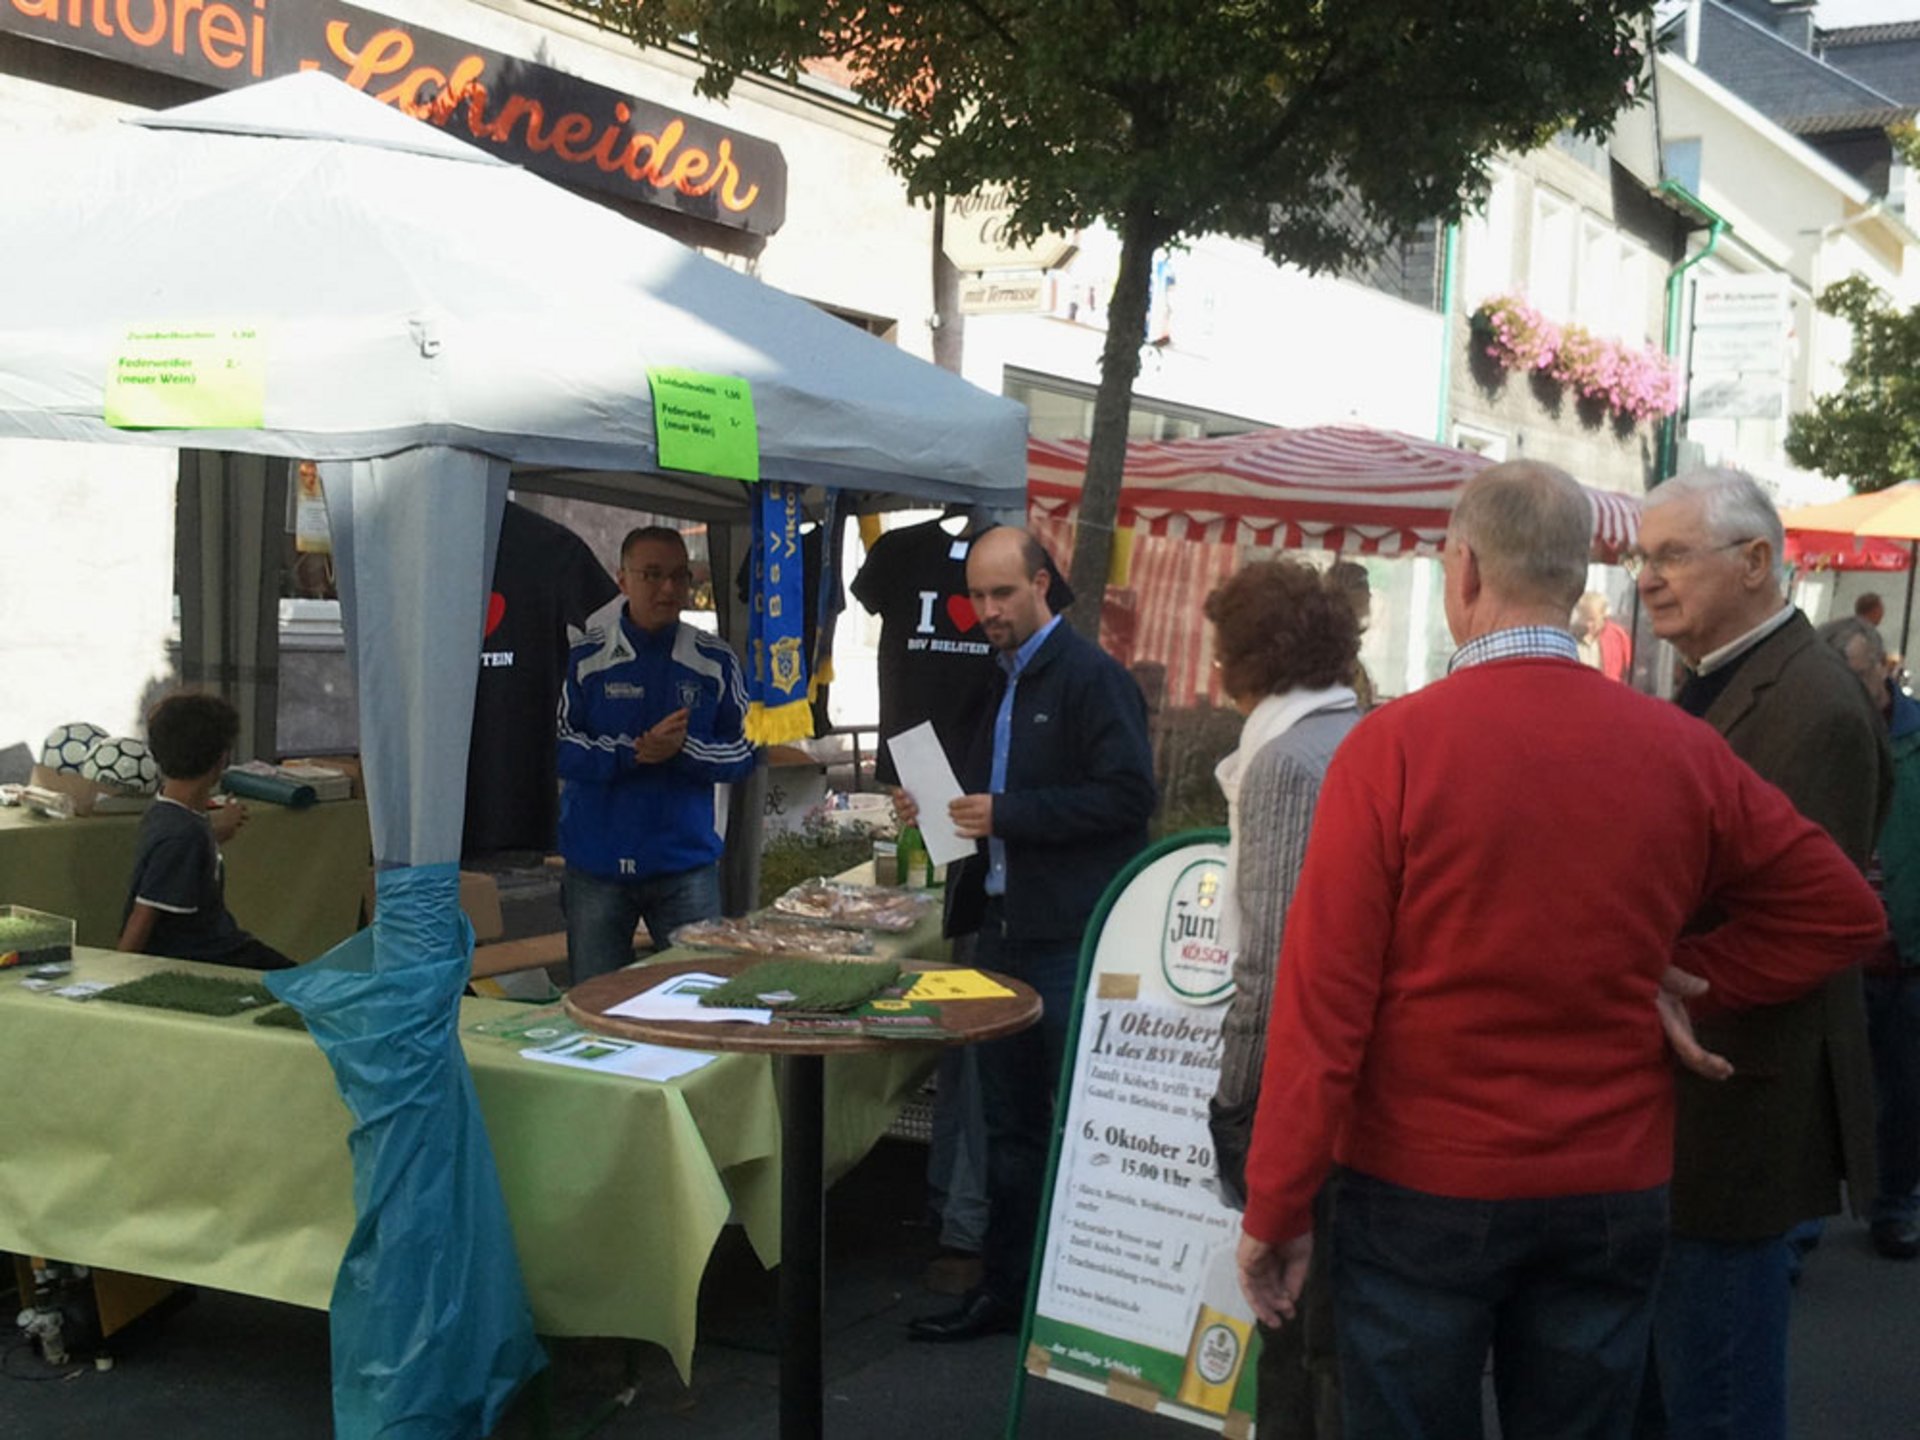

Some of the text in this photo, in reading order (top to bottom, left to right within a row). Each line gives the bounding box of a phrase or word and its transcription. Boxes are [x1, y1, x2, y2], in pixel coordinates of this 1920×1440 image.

[325, 20, 759, 211] Schneider
[118, 358, 193, 368] Federweißer
[117, 373, 197, 384] (neuer Wein)
[916, 591, 938, 633] I
[907, 638, 990, 655] BSV BIELSTEIN
[619, 858, 637, 875] TR
[1182, 943, 1229, 966] KÖLSCH
[1116, 1041, 1144, 1060] des
[1145, 1046, 1179, 1063] BSV
[1082, 1119, 1100, 1142] 6.
[1104, 1125, 1181, 1160] Oktober
[1120, 1157, 1192, 1189] 15.00 Uhr
